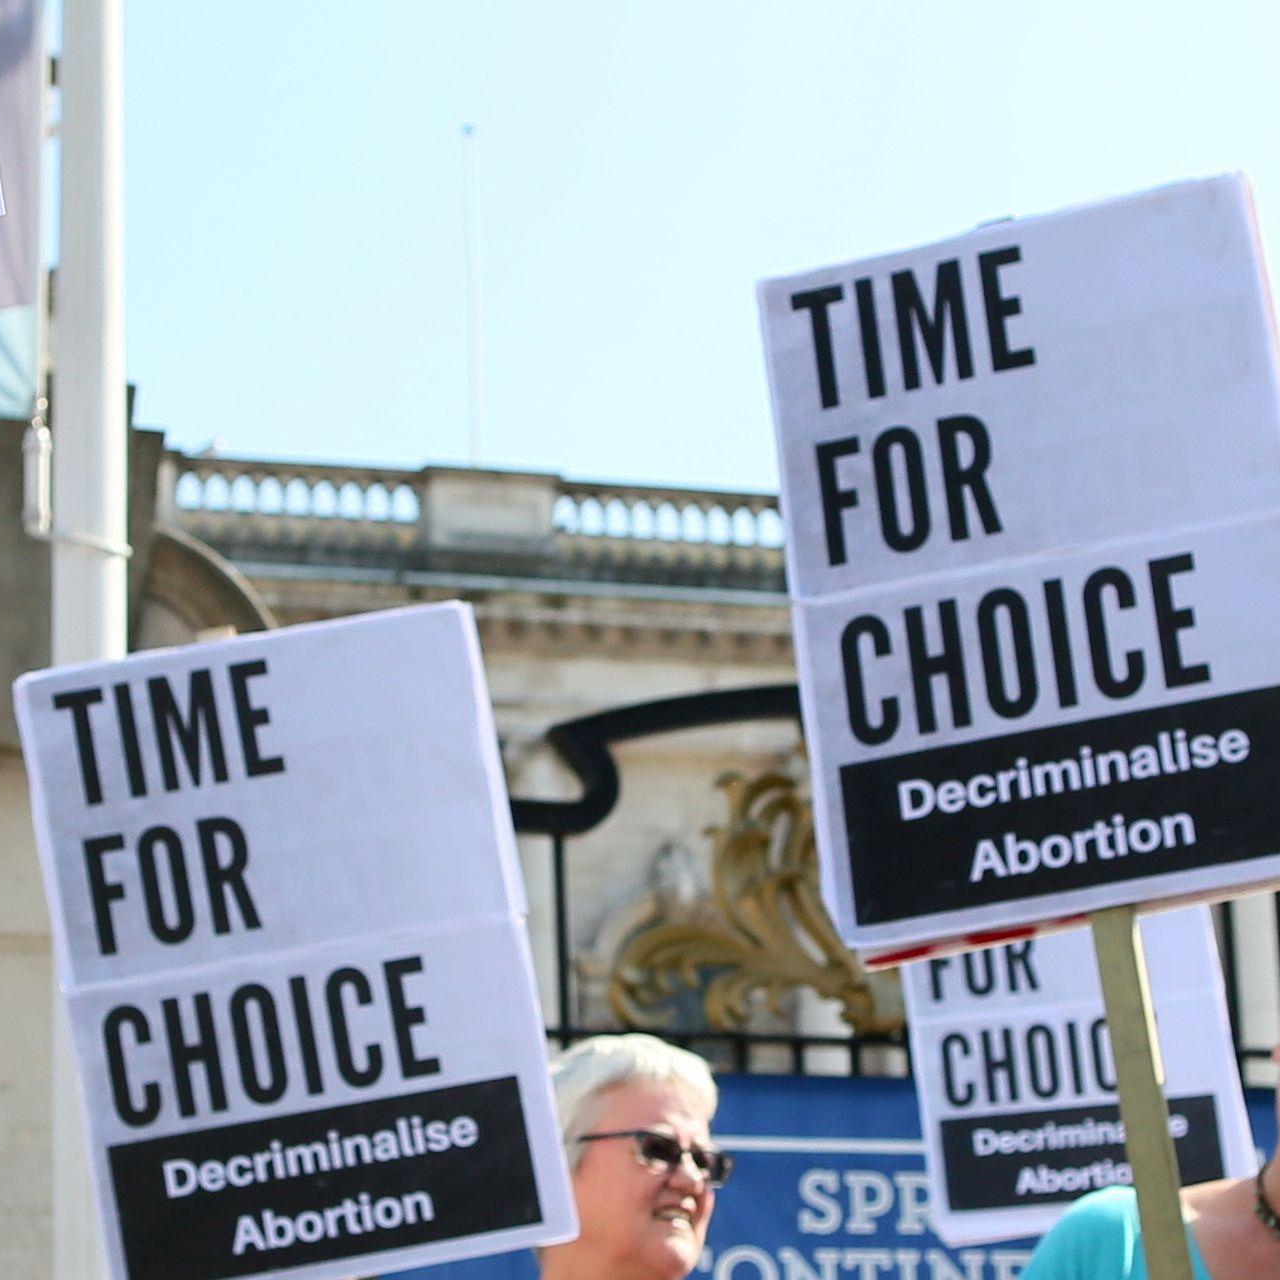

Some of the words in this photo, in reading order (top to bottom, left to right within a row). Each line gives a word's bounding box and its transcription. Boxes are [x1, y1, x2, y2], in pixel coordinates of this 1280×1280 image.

[790, 244, 1036, 409] TIME
[815, 414, 1003, 566] FOR
[840, 552, 1211, 746] CHOICE
[52, 659, 285, 807] TIME
[898, 729, 1251, 821] Decriminalise
[82, 815, 262, 956] FOR
[971, 808, 1196, 883] Abortion
[929, 939, 1039, 1002] FOR
[102, 955, 441, 1129] CHOICE
[941, 1018, 1119, 1108] CHOIC
[163, 1115, 478, 1200] Decriminalise
[798, 1168, 935, 1235] SPR
[1016, 1160, 1134, 1195] Abortio
[233, 1191, 434, 1255] Abortion
